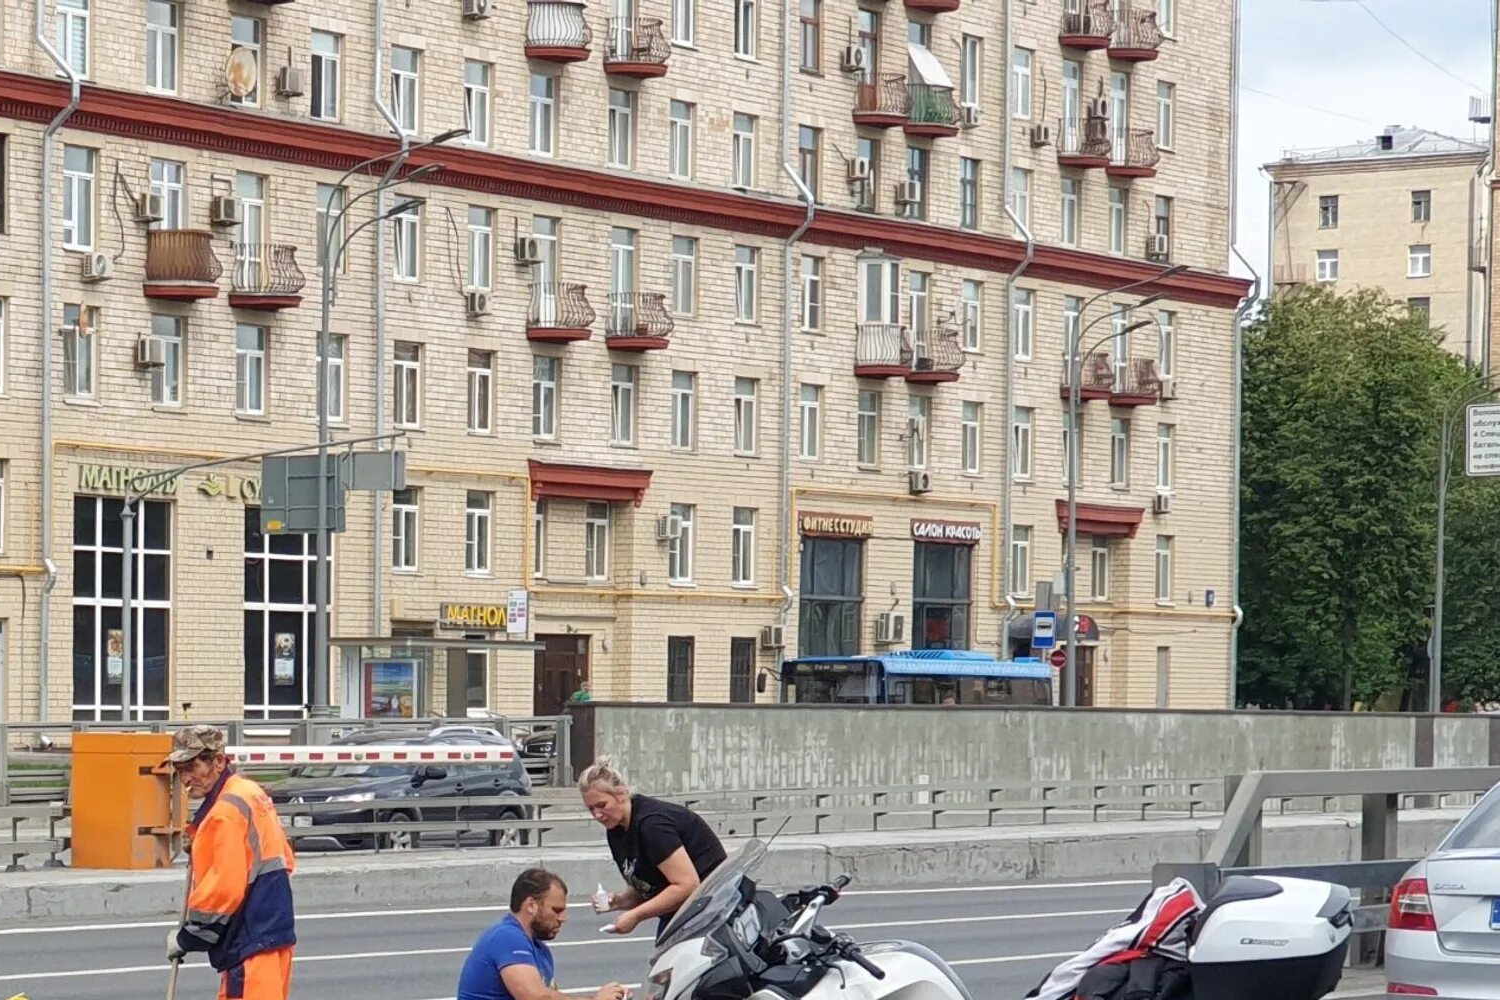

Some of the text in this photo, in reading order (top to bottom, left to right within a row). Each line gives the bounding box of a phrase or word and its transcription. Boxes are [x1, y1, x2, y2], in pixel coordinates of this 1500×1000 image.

[913, 522, 982, 540] САЛОН КРАСОТЫ
[447, 604, 507, 625] МАГНОЛ
